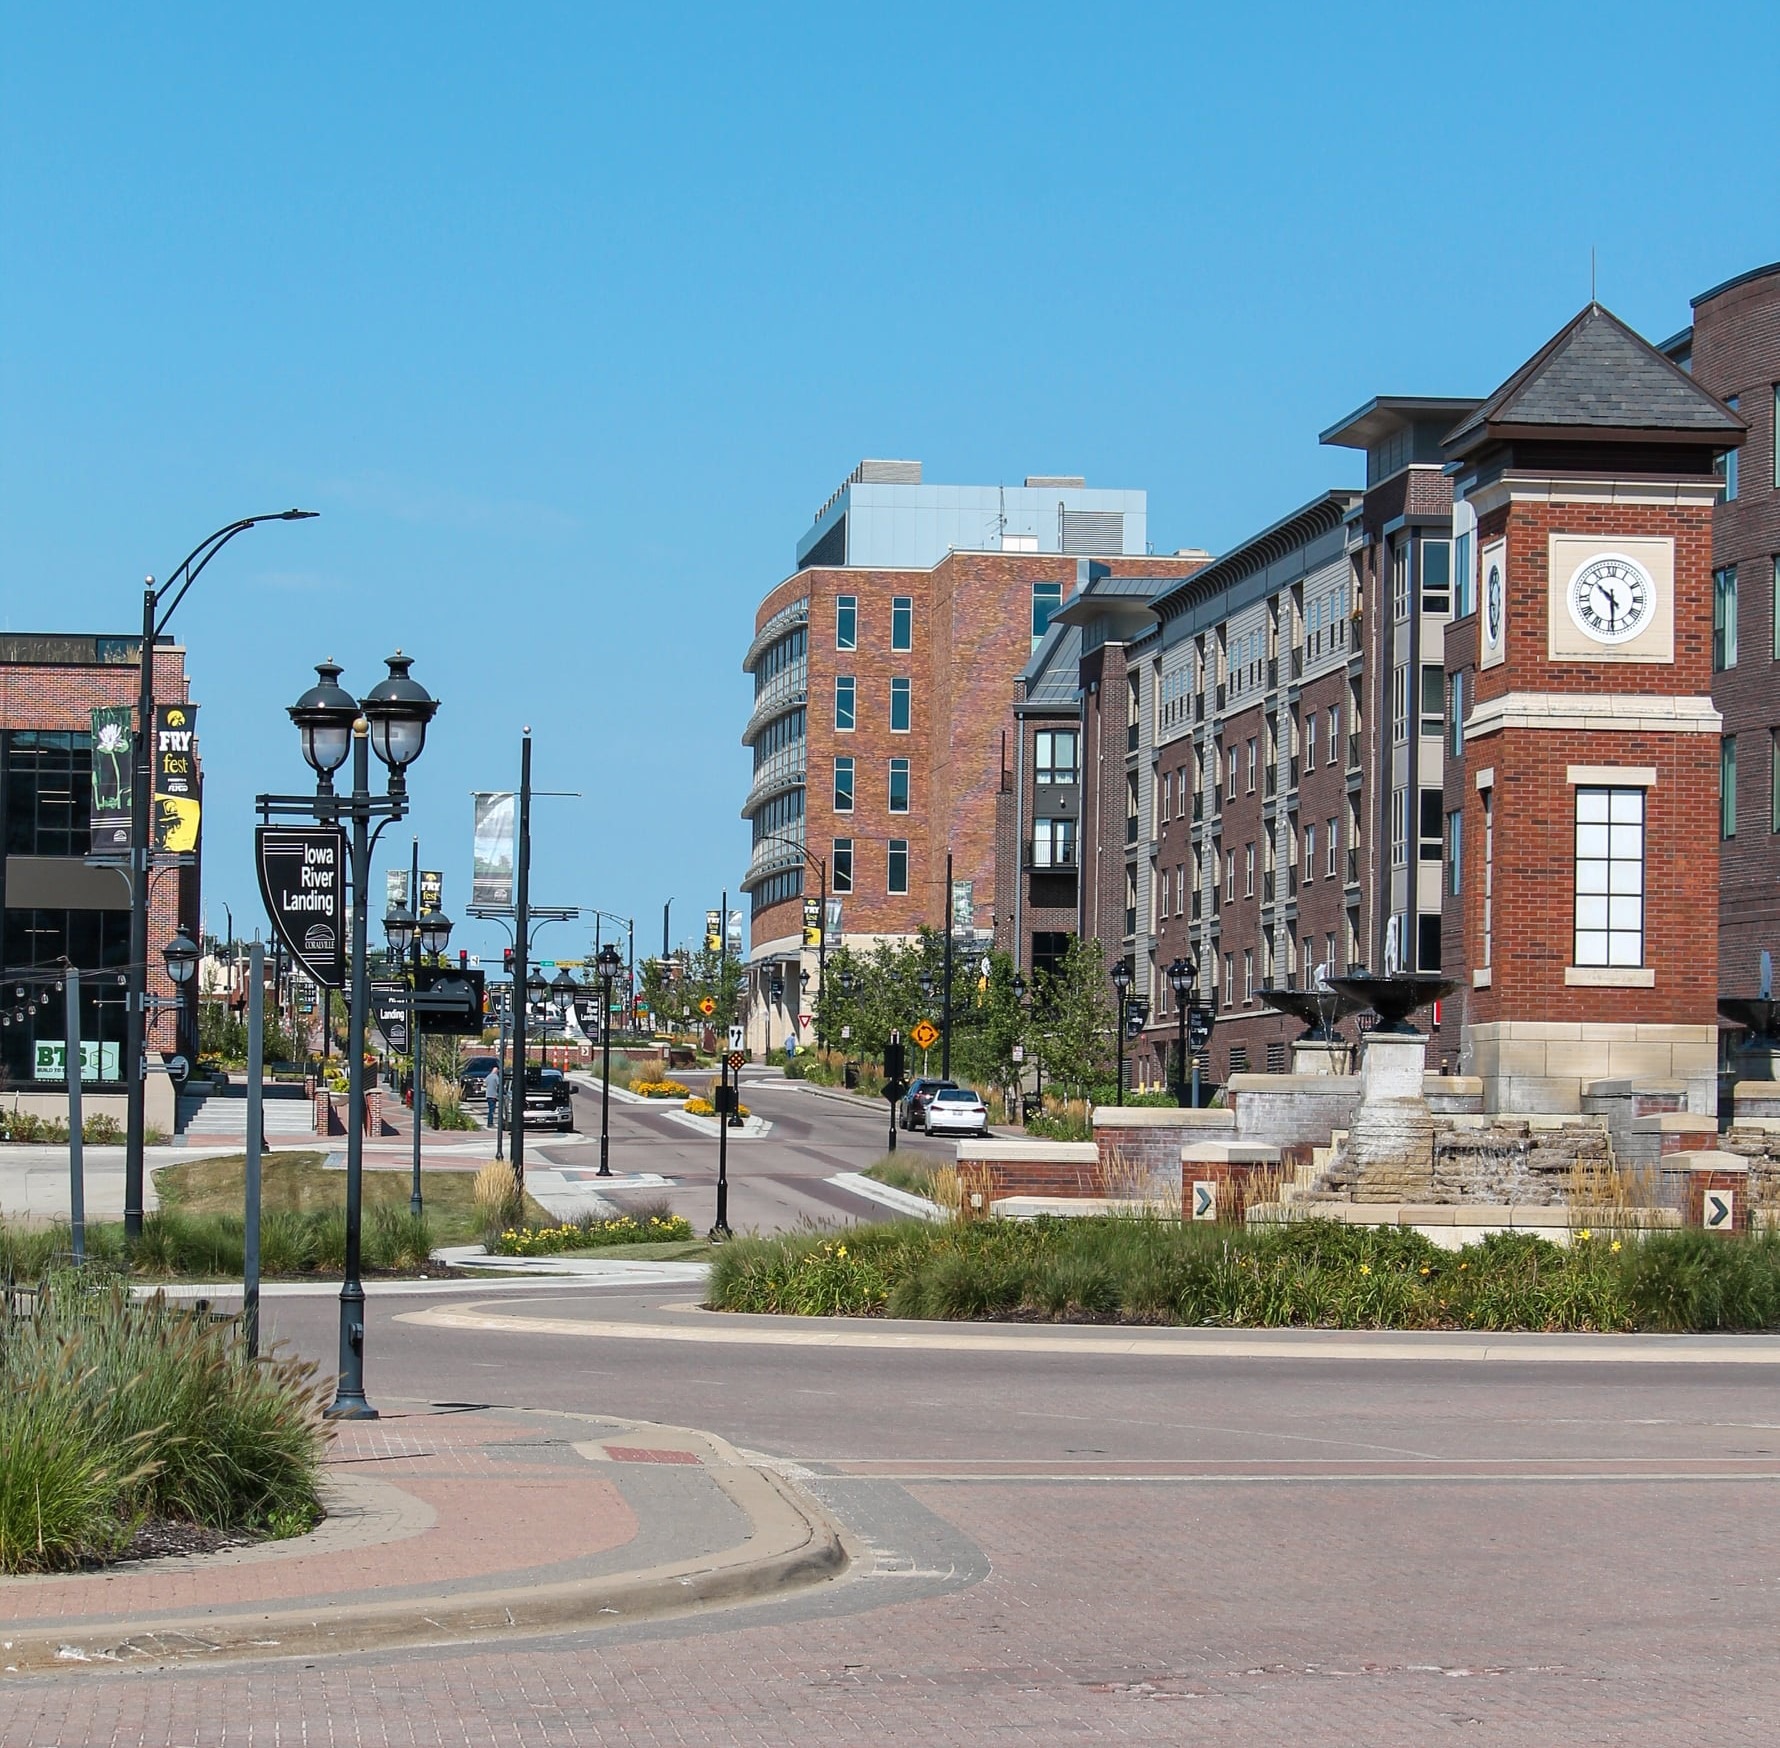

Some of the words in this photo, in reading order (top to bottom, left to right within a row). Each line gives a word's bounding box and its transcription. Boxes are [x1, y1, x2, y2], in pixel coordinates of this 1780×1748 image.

[159, 731, 192, 751] FRY
[163, 753, 188, 773] fest
[304, 843, 334, 864] Iowa
[301, 866, 334, 887] River
[421, 881, 441, 891] FRY
[283, 889, 334, 916] Landing
[304, 941, 335, 949] CORALVILLE
[380, 1008, 405, 1021] Landing
